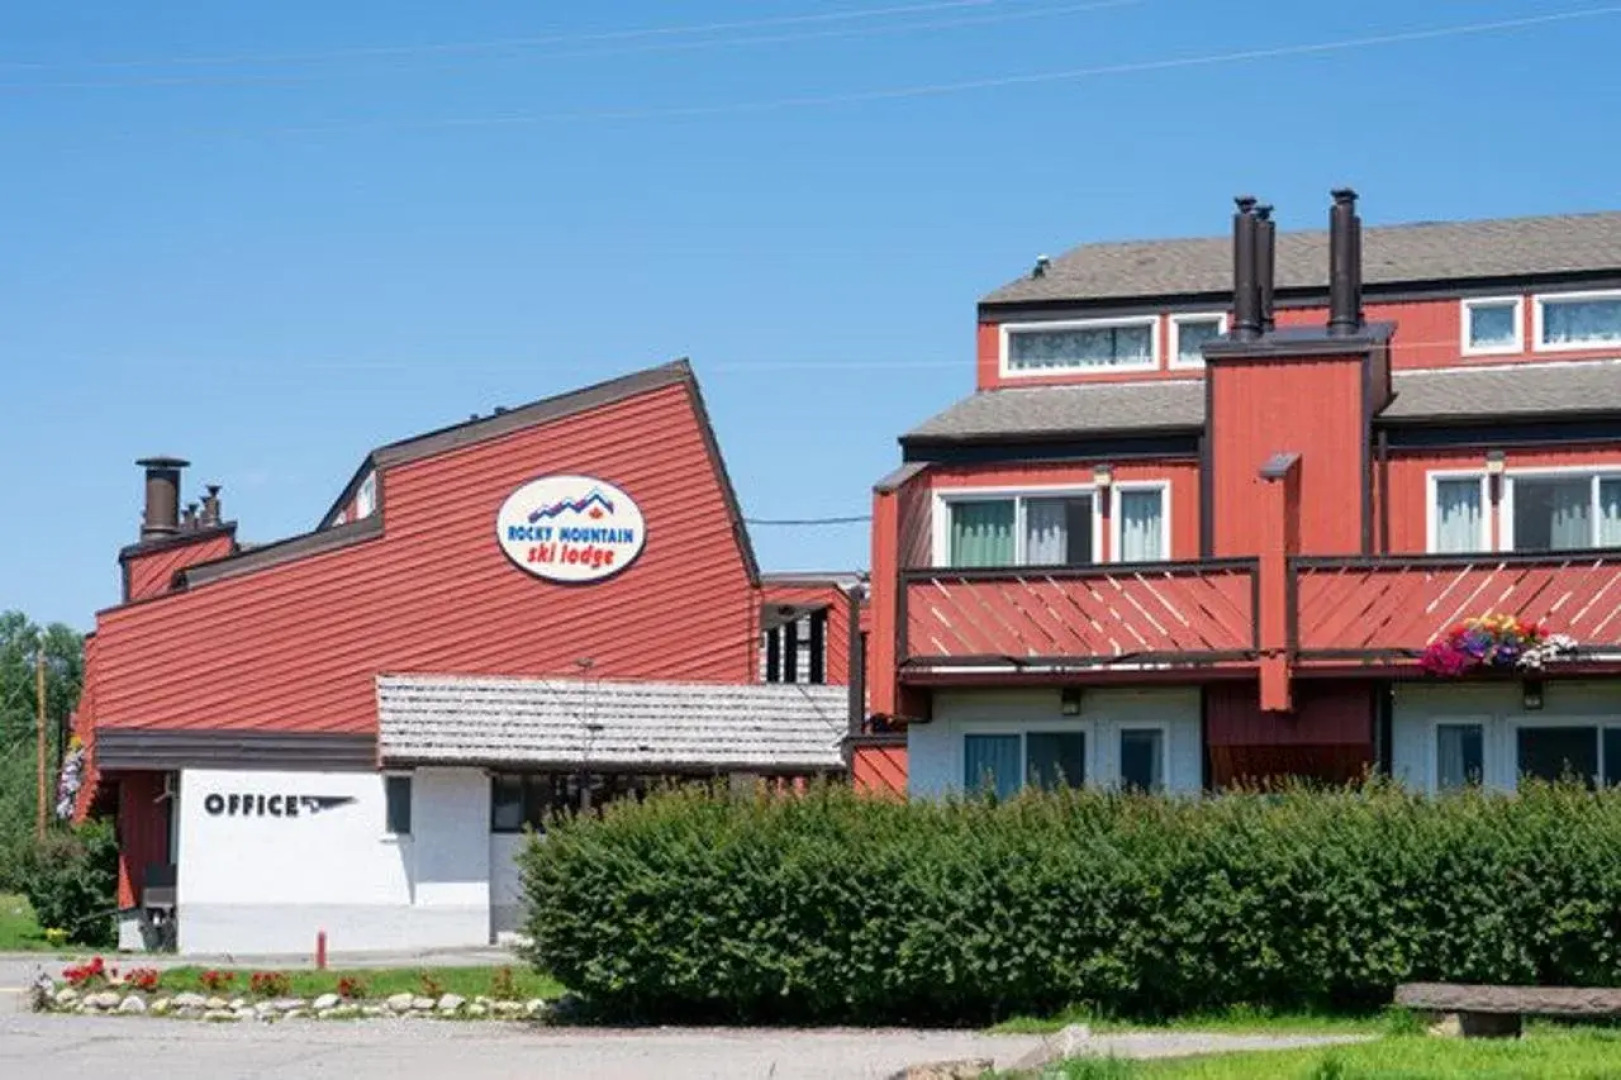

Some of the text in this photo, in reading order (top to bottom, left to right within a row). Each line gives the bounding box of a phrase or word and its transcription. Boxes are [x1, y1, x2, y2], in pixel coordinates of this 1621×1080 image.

[508, 526, 634, 543] ROCKY MOUNTAIN
[527, 543, 614, 569] ski lodge
[204, 793, 298, 817] OFFICE
